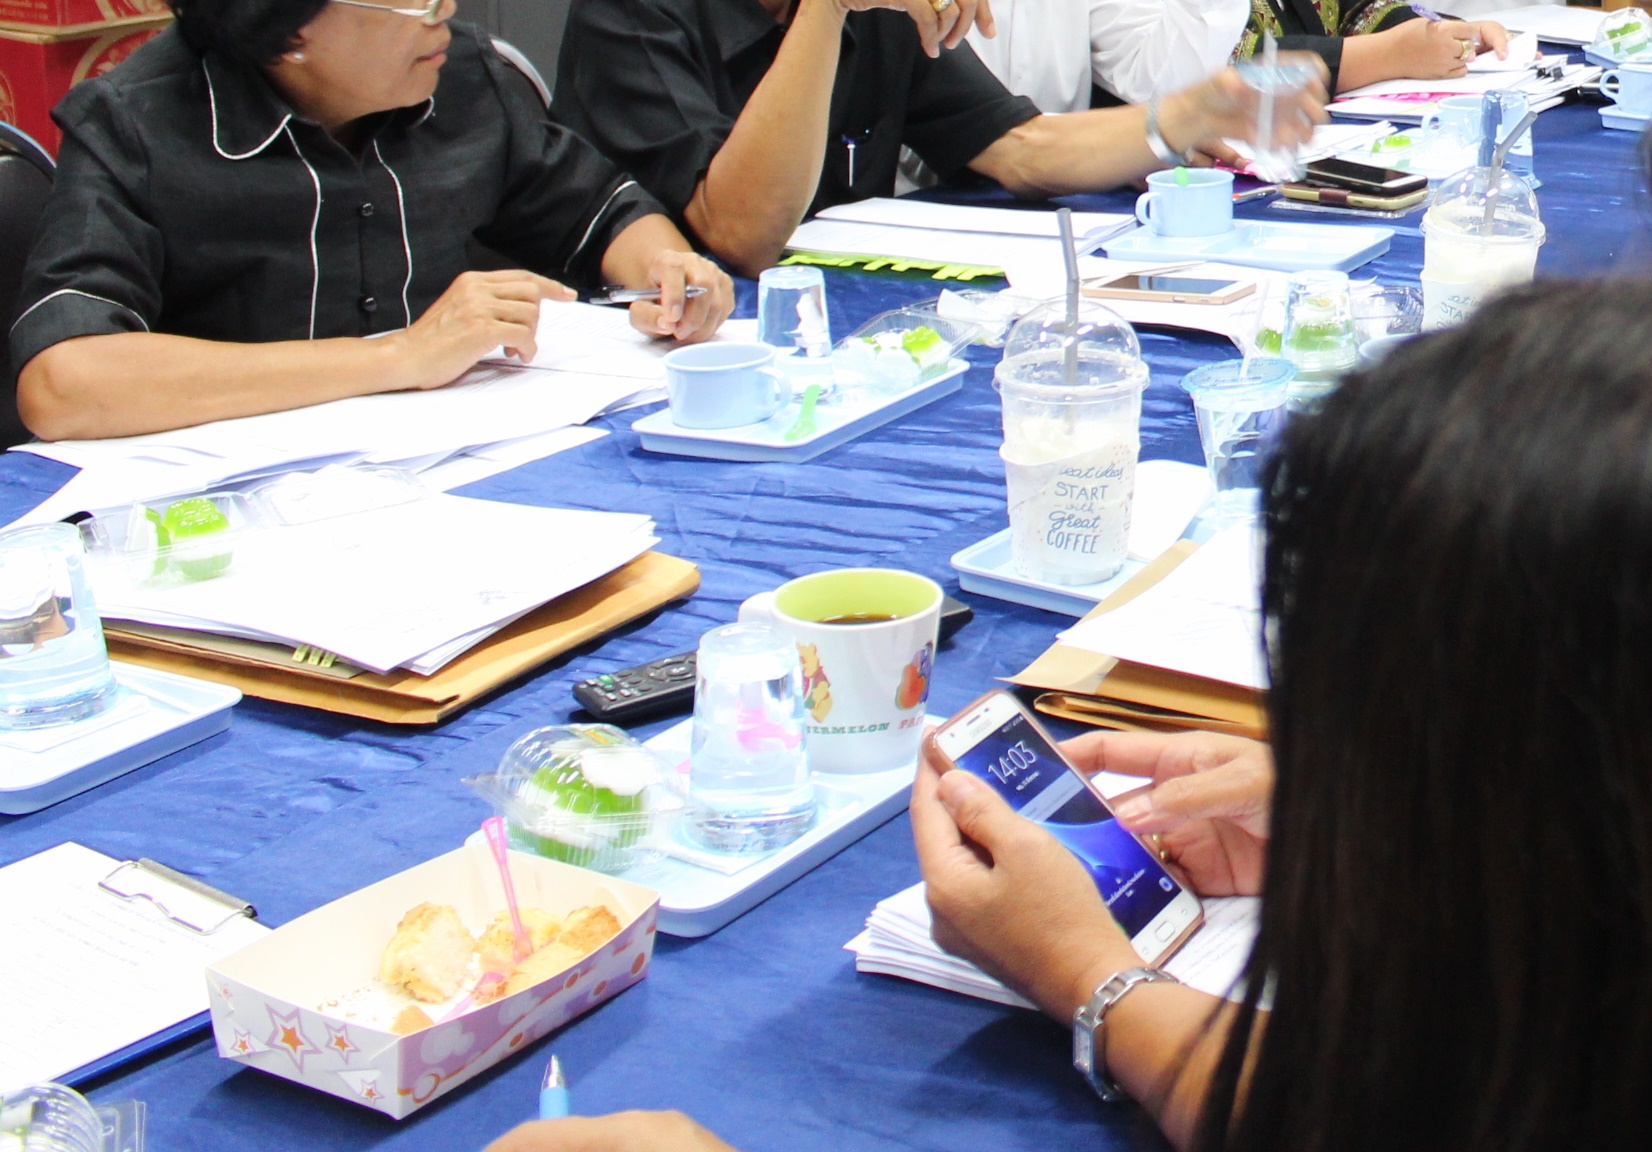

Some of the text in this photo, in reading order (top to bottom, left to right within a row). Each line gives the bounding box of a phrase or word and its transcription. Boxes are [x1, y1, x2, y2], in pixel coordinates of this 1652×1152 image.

[1054, 481, 1109, 500] START
[1048, 510, 1101, 531] Great
[1046, 529, 1100, 554] COFFEE
[987, 739, 1037, 785] 14:03
